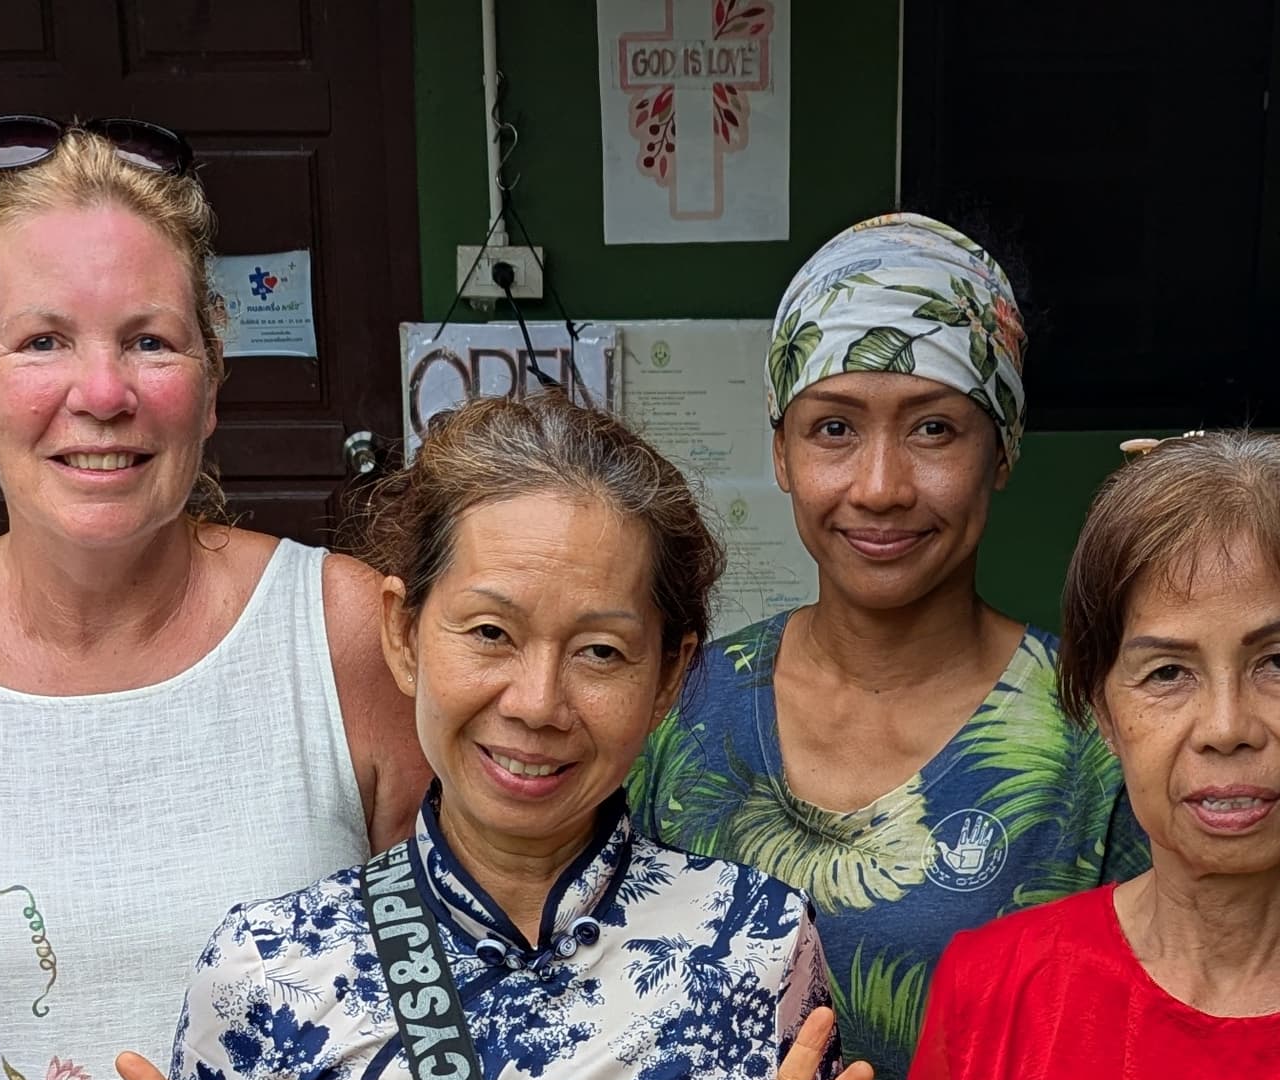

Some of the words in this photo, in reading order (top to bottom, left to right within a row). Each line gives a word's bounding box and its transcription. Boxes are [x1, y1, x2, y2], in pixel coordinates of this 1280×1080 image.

[631, 48, 676, 77] GOD
[683, 48, 702, 76] IS
[708, 47, 754, 77] LOVE
